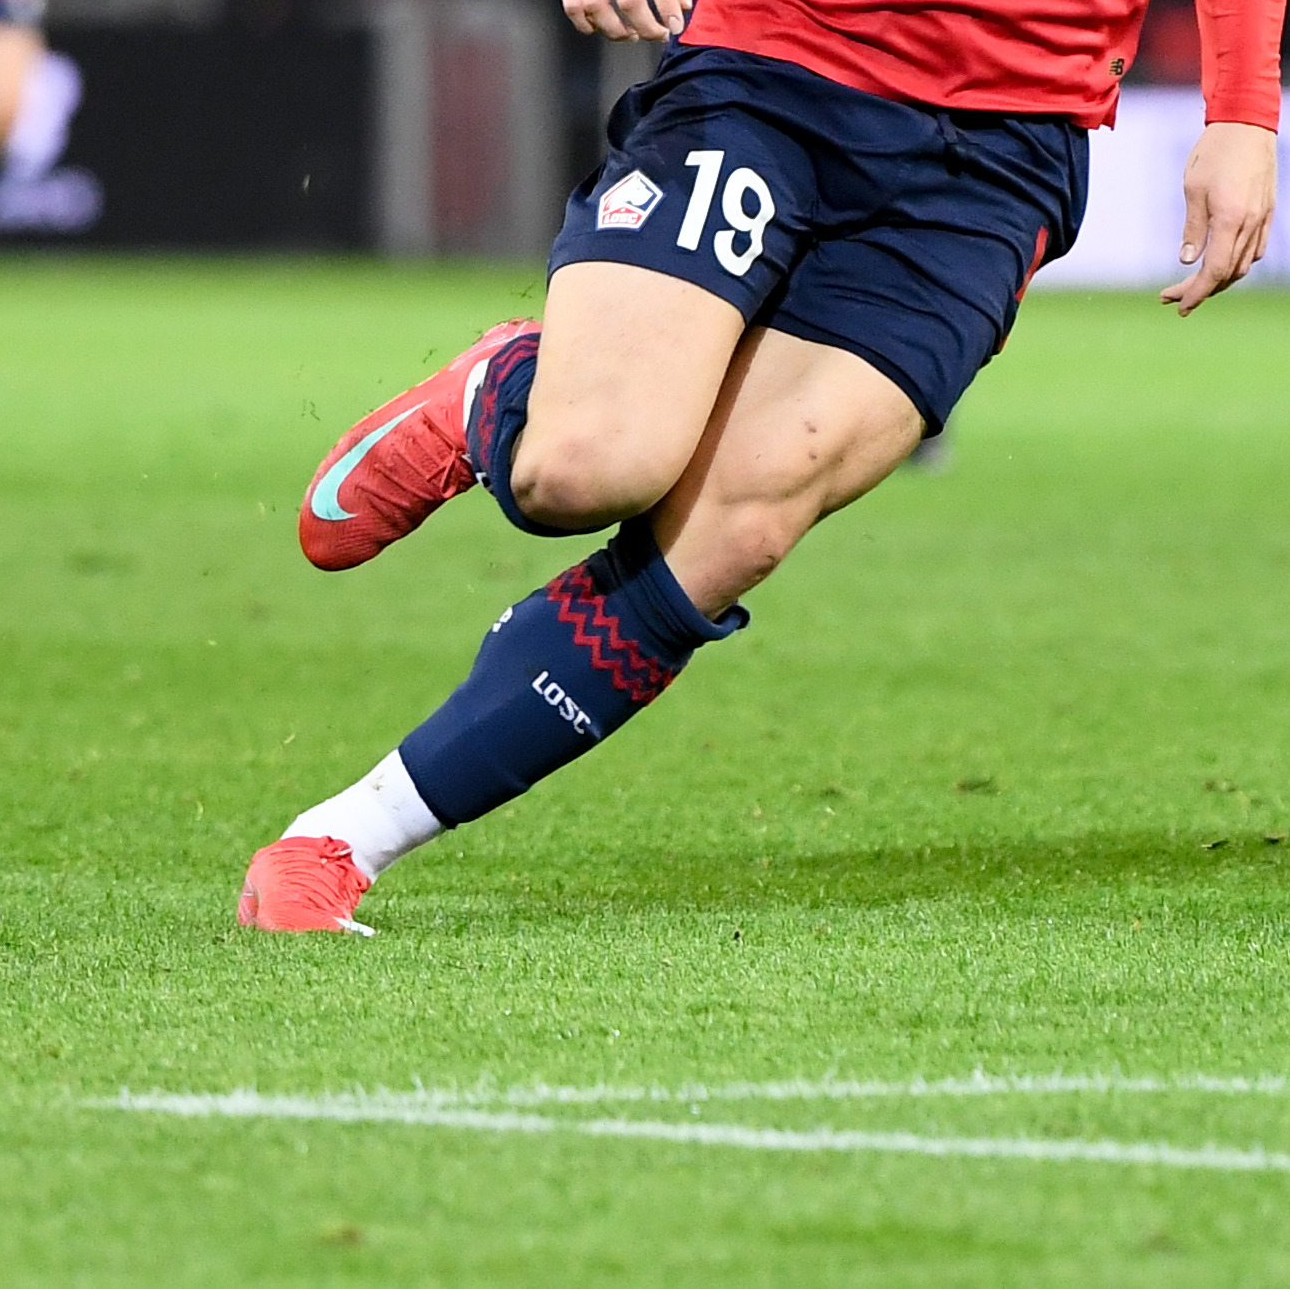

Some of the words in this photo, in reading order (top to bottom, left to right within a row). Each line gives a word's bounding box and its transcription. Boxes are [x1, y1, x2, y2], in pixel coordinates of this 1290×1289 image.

[603, 211, 638, 224] LOSC
[676, 150, 776, 277] 19
[532, 670, 591, 735] LOSC
